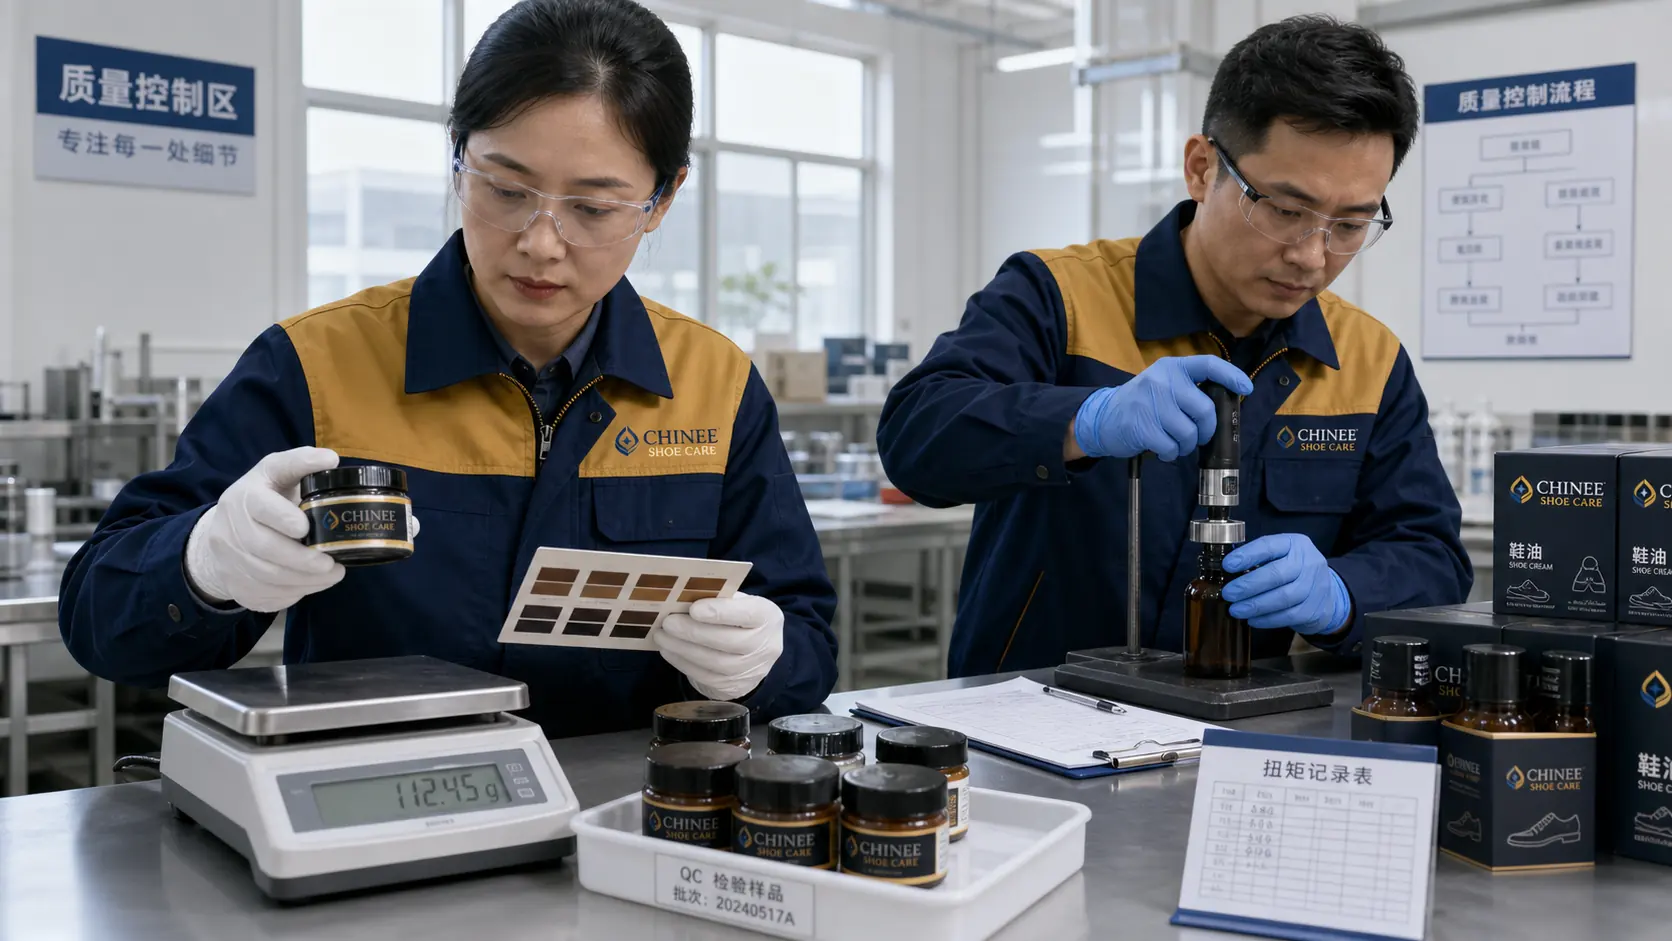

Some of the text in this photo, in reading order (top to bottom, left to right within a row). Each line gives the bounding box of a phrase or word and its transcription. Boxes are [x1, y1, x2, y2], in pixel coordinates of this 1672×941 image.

[59, 63, 238, 120] 质量控制区
[1457, 78, 1596, 114] 质量控制流程
[58, 128, 240, 167] 专注每一处细节
[643, 428, 719, 446] CHINEE
[1297, 428, 1357, 442] CHINEE
[648, 445, 717, 457] SHOE CARE
[1300, 443, 1356, 451] SHOE CARE
[1536, 480, 1604, 496] CHINEE
[1540, 496, 1603, 508] SHOE CARE
[341, 509, 397, 523] CHINEE
[344, 523, 395, 532] SHOE CARE
[1509, 542, 1543, 561] 鞋油
[1632, 546, 1667, 566] 鞋油
[1508, 561, 1554, 571] SHOE CREAM
[1632, 566, 1672, 576] SHOE CREA
[1263, 759, 1373, 786] 扭矩记录表
[1526, 767, 1582, 782] CHINEE
[396, 773, 479, 809] 112.45
[485, 783, 499, 803] g
[1530, 782, 1580, 791] SHOE CARE
[1637, 779, 1664, 793] SHOE
[663, 816, 719, 831] CHINEE
[665, 831, 717, 841] SHOE CARE
[754, 832, 815, 848] CHINEE
[859, 841, 922, 858] CHINEE
[891, 857, 919, 868] CARE
[680, 866, 784, 903] QC 检验样品
